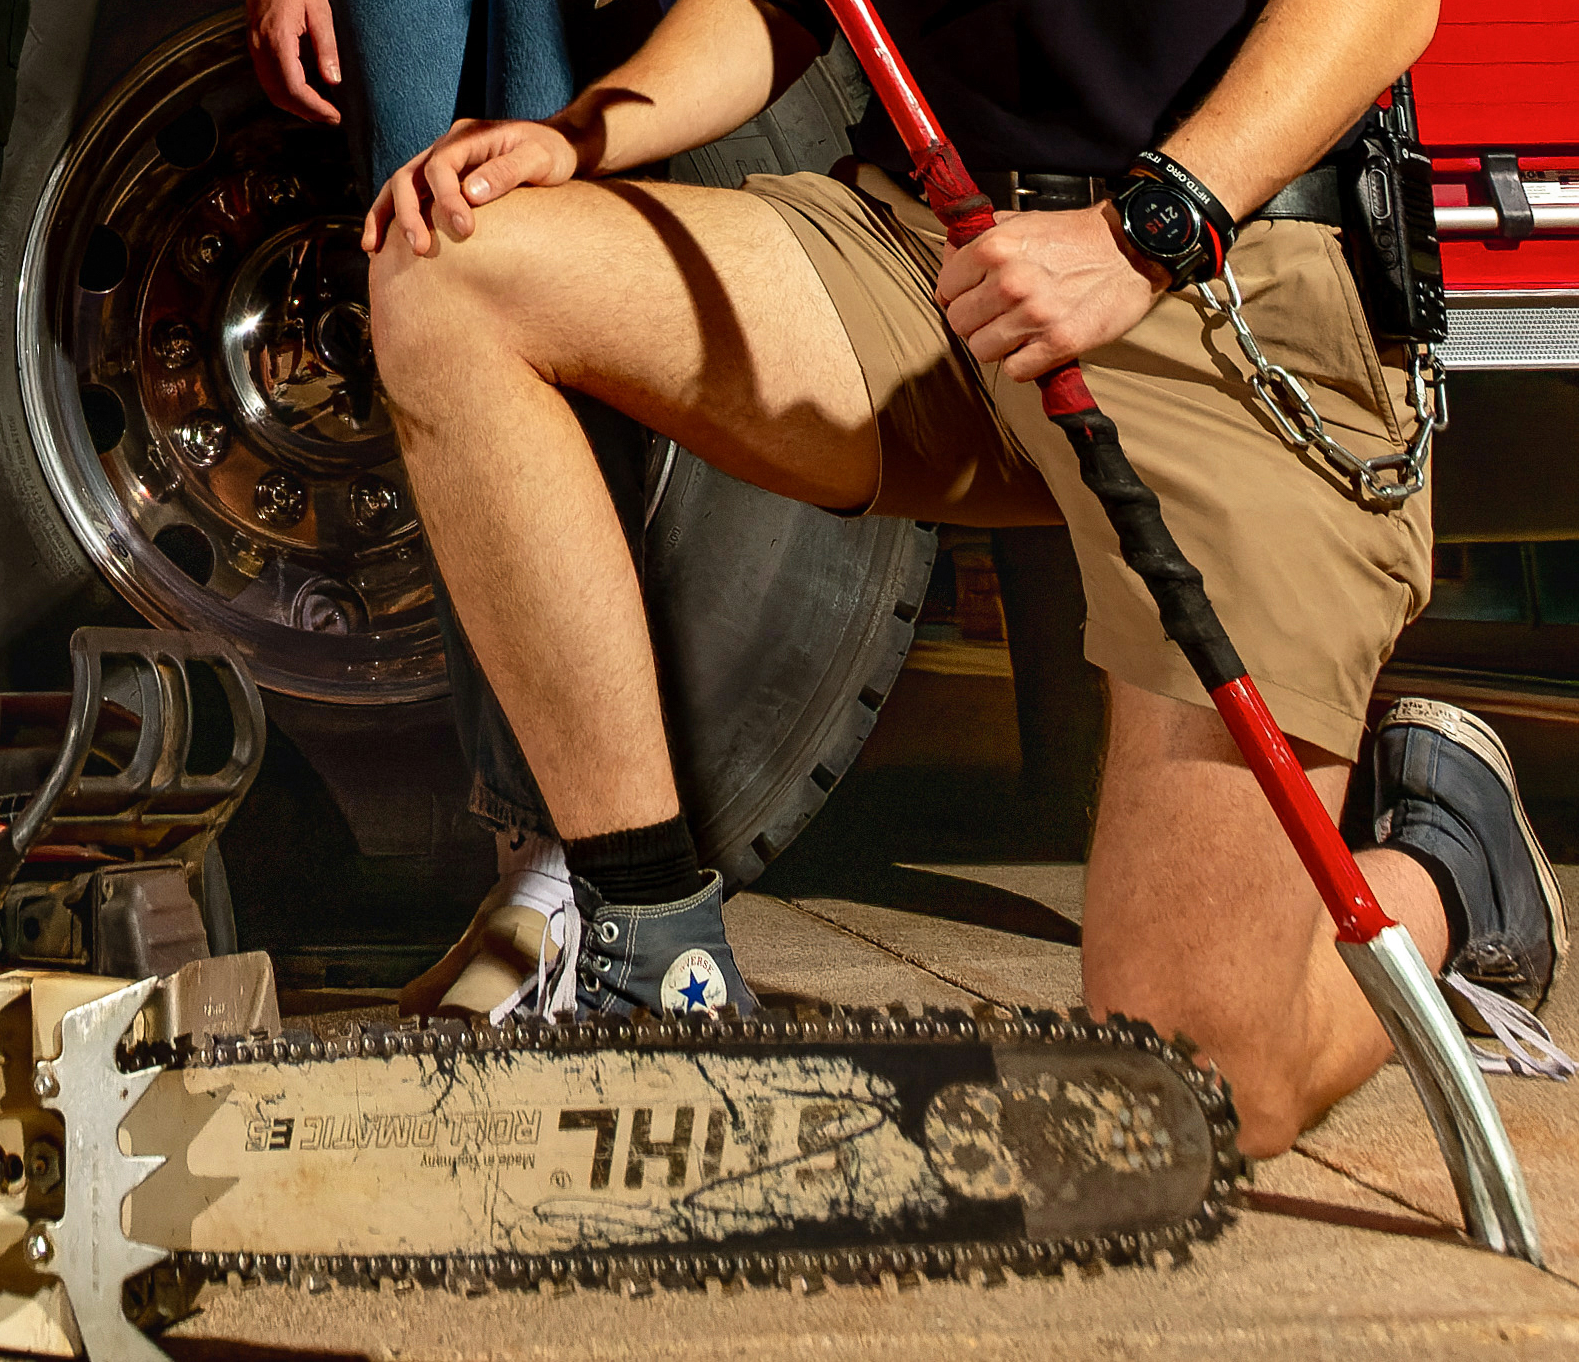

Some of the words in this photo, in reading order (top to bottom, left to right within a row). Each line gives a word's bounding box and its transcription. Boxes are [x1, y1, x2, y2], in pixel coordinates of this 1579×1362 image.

[1165, 163, 1211, 205] HFTD.ORG
[300, 1109, 543, 1149] ROLLOMATIC
[483, 1155, 495, 1169] in
[498, 1152, 536, 1170] Made
